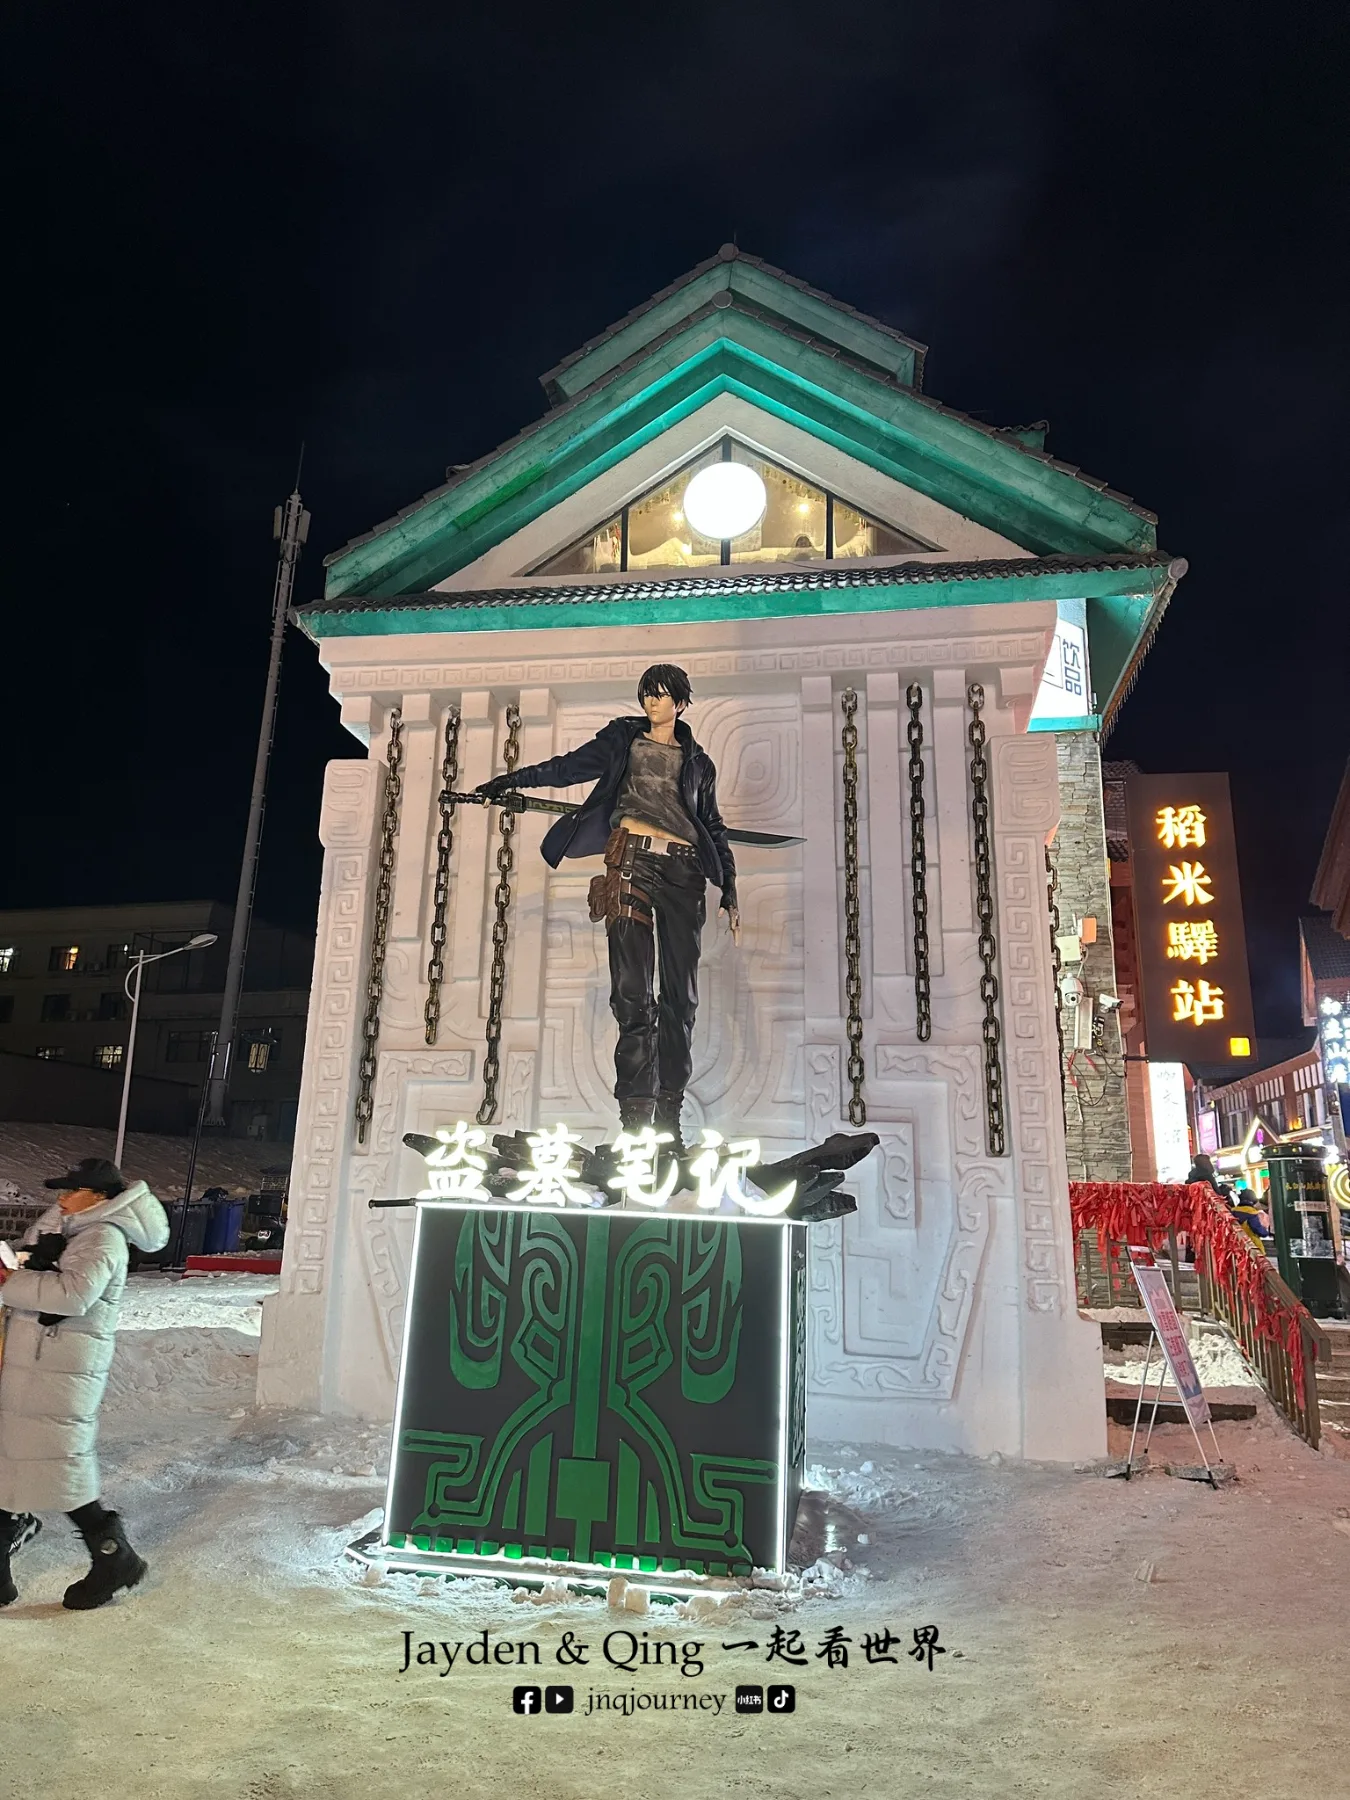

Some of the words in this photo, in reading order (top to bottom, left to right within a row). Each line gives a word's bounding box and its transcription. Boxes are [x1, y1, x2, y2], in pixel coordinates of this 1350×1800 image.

[1062, 638, 1082, 696] 饮品
[1155, 804, 1225, 1027] 稻米驛站
[416, 1120, 798, 1216] 盗墓笔记
